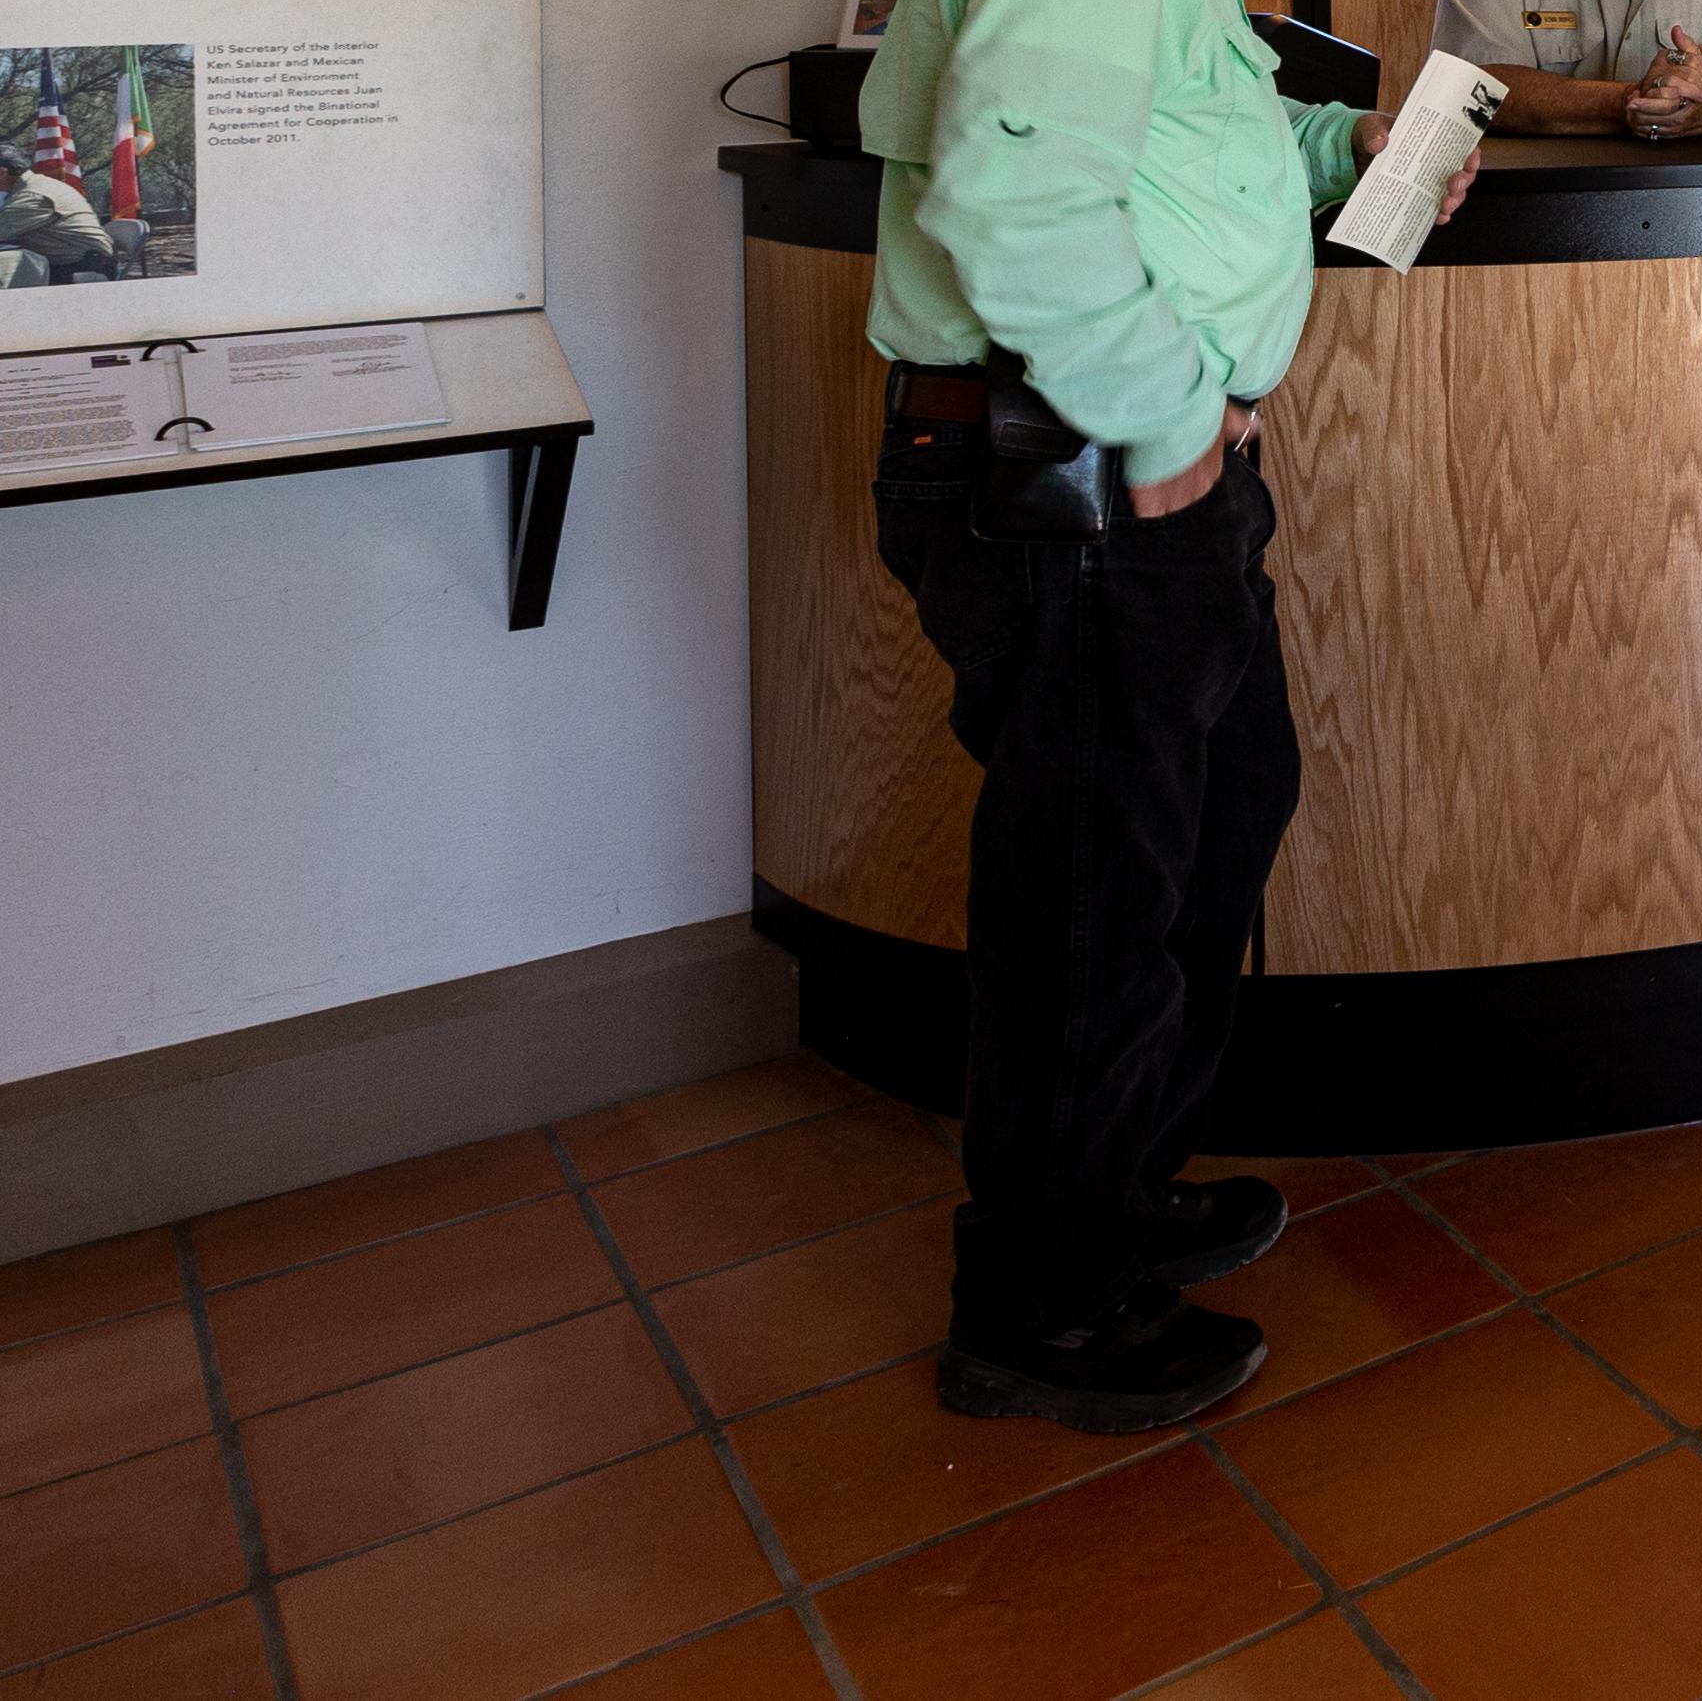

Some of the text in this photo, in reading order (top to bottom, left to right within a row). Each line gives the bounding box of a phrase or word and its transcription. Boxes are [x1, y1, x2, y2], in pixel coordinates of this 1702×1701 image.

[206, 41, 379, 55] US Secretary of the Interior
[206, 57, 364, 69] Ken Salazar and Mexican
[207, 72, 359, 84] Minister of Environment
[207, 85, 383, 100] and Natural Resources Juan
[207, 100, 380, 115] Elvira signed the Binational
[208, 114, 399, 132] Agreement for Cooperation in
[208, 135, 262, 146] October
